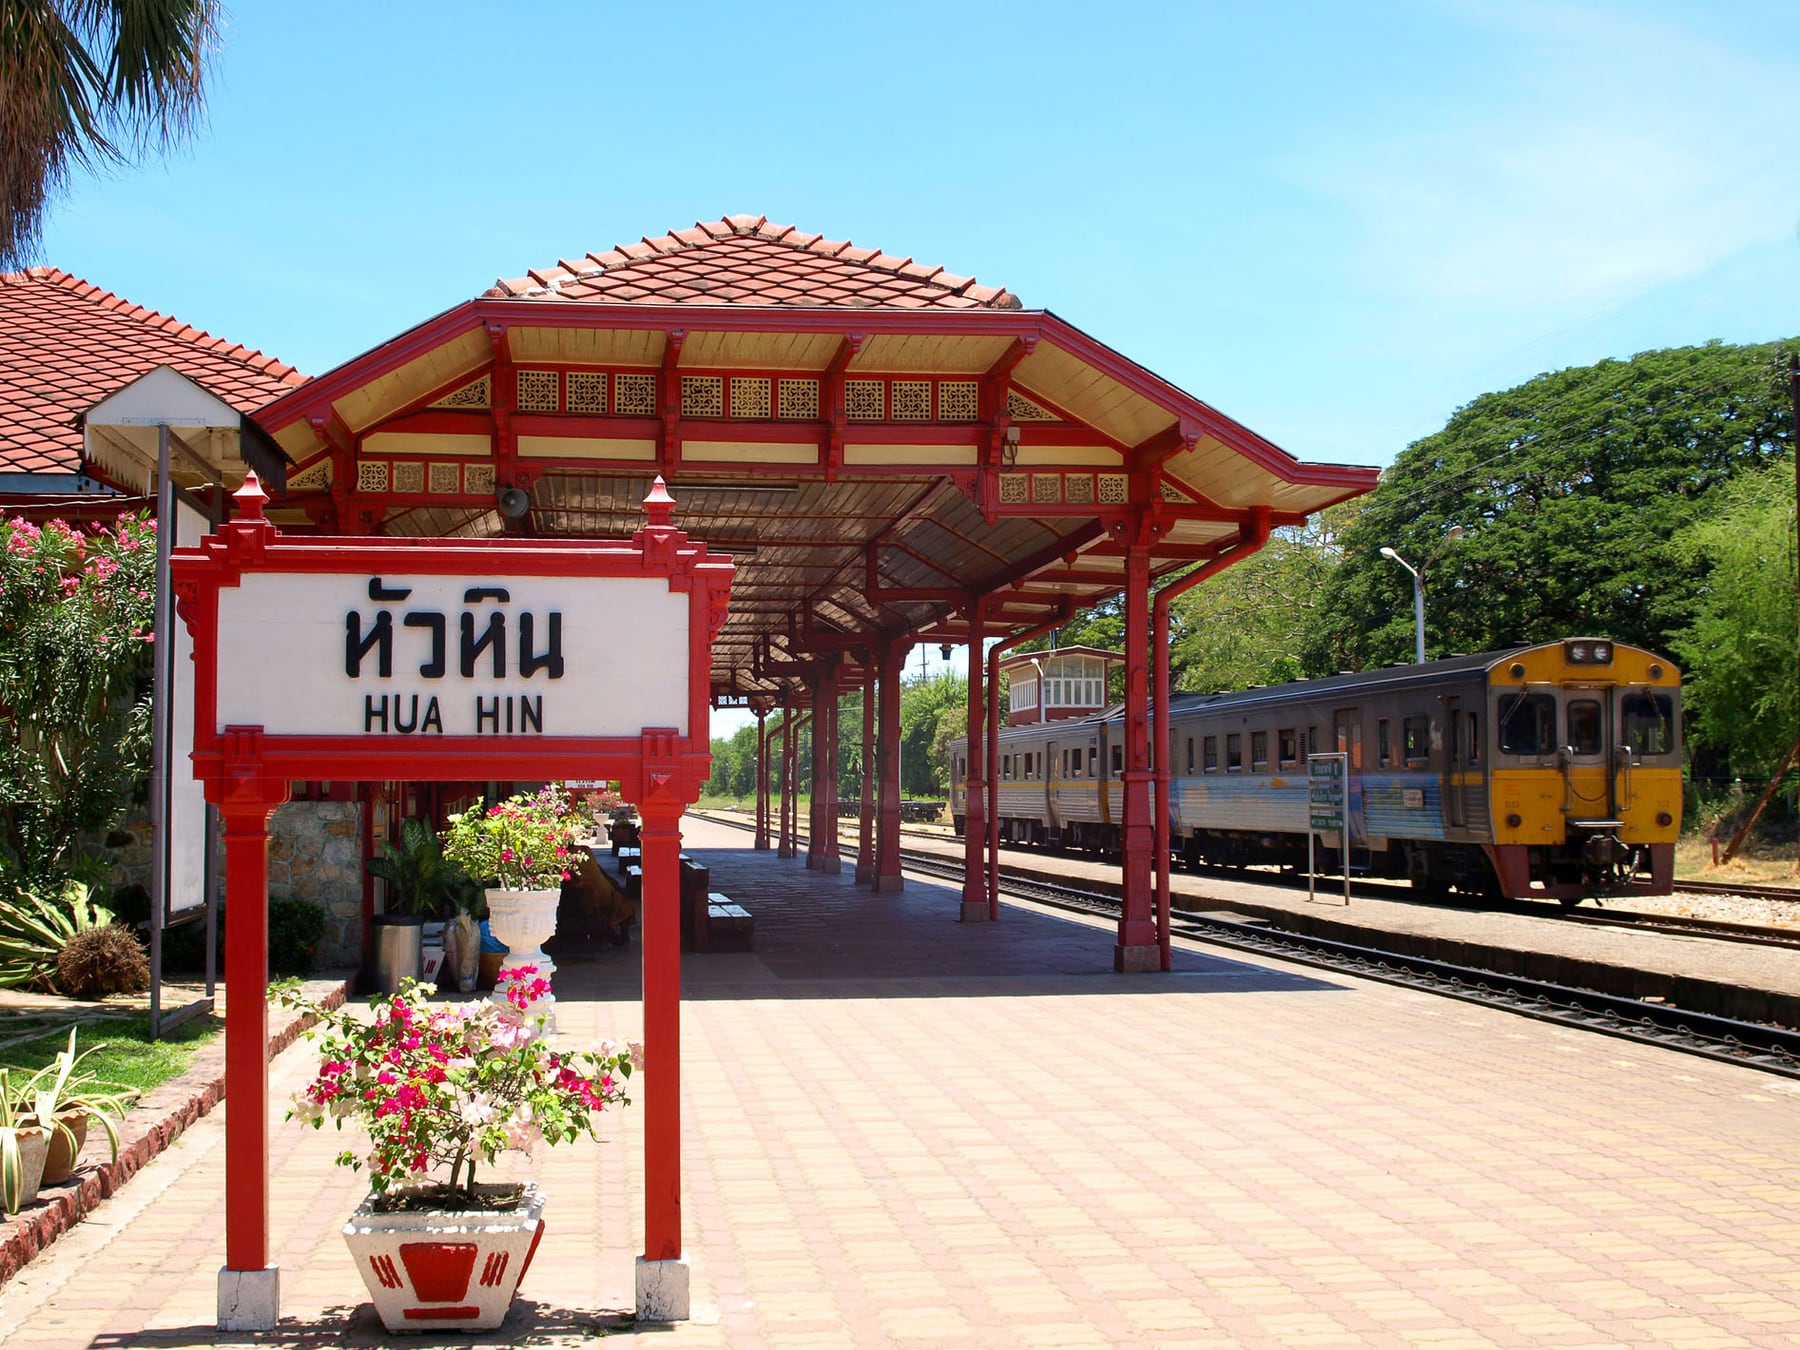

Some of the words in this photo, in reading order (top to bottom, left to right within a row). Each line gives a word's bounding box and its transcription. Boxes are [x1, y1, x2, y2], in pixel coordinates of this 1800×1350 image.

[345, 577, 565, 680] หัวหิน
[364, 694, 443, 735] HUA
[476, 695, 543, 734] HIN
